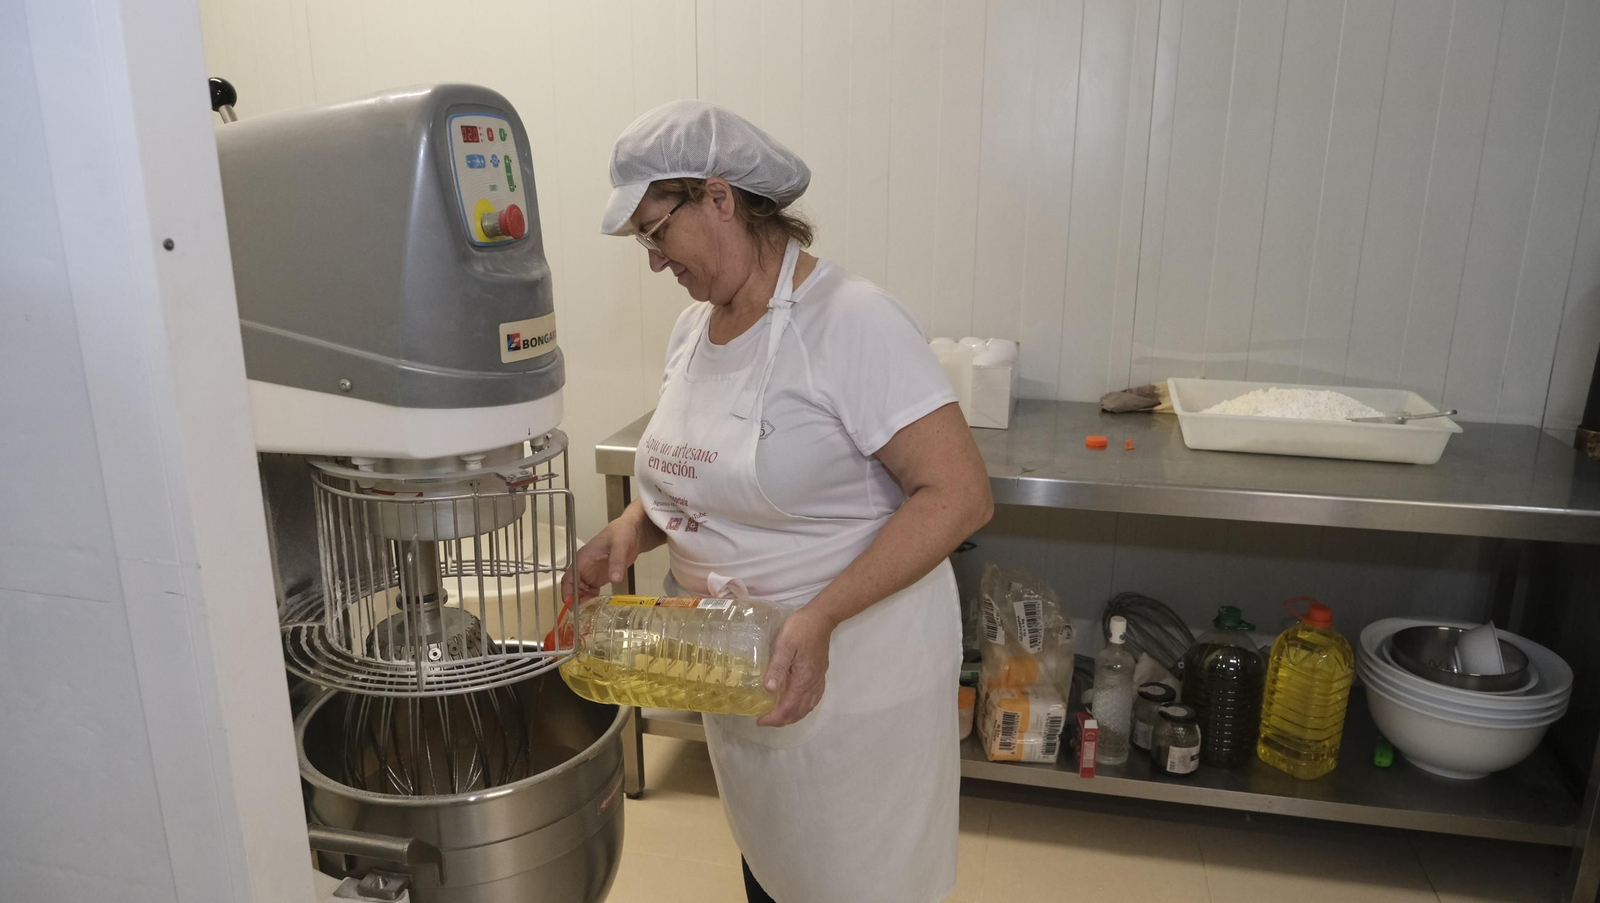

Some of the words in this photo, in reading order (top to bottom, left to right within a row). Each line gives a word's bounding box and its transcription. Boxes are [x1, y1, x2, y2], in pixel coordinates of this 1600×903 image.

[660, 442, 673, 456] un
[672, 442, 718, 464] artesano
[648, 455, 660, 470] en
[660, 460, 698, 479] acción.
